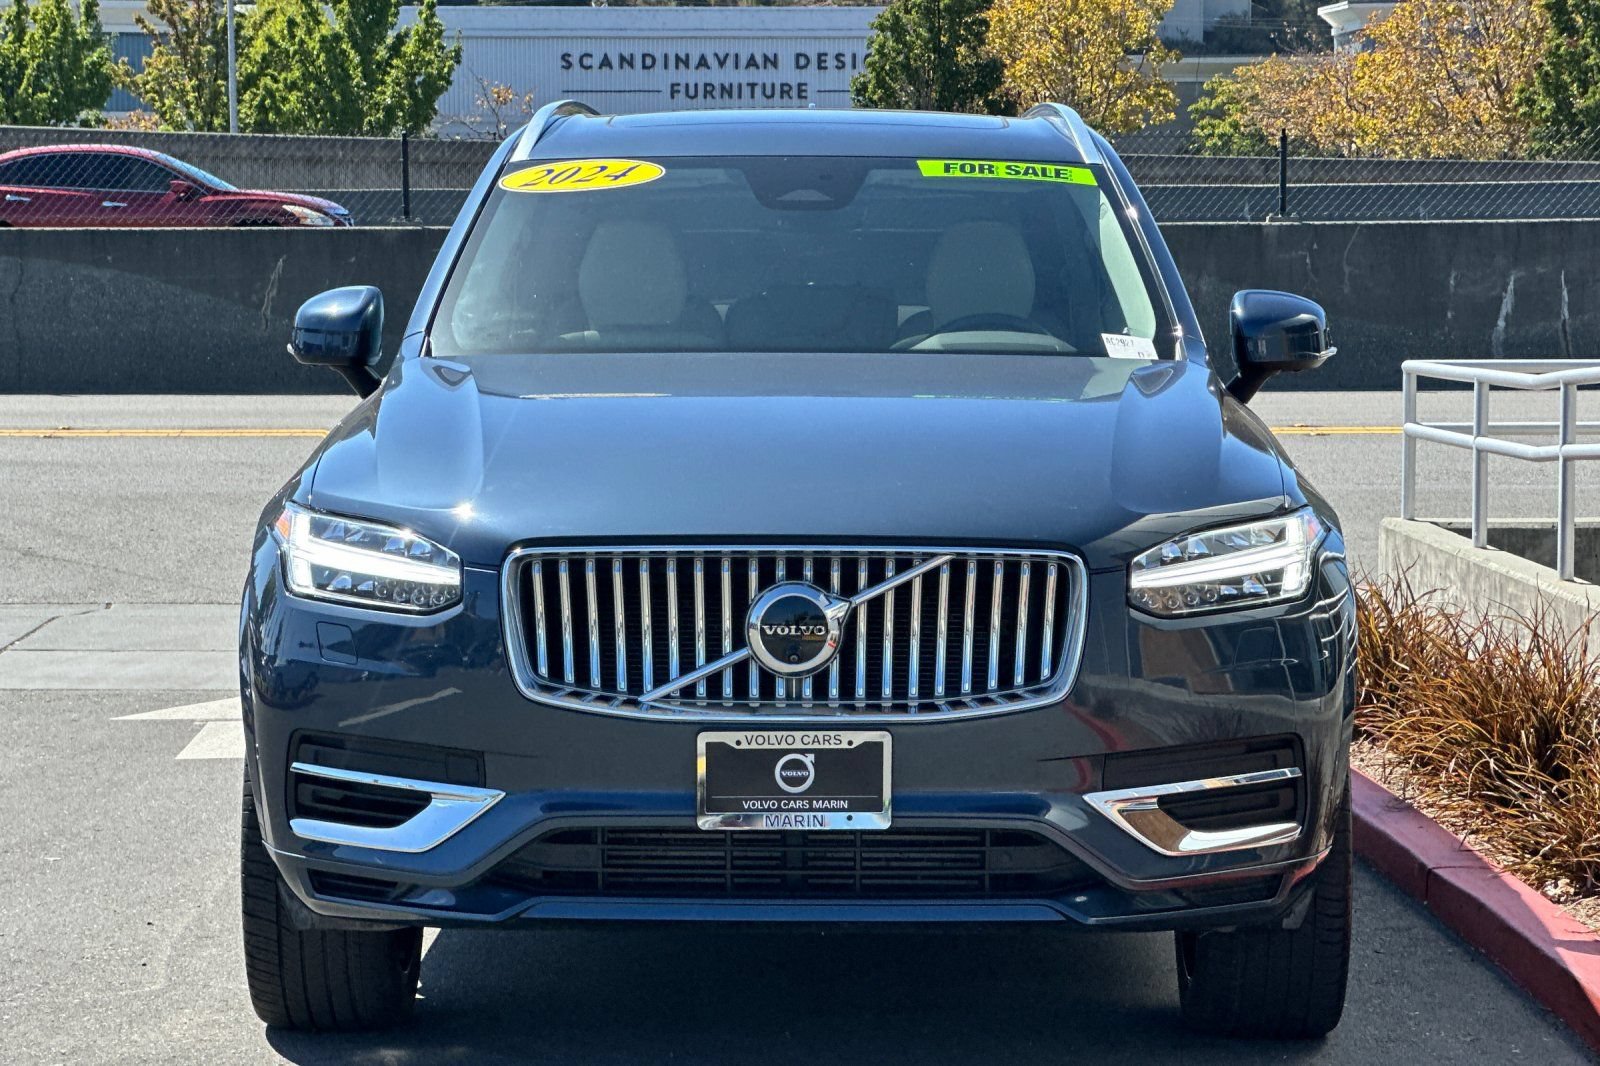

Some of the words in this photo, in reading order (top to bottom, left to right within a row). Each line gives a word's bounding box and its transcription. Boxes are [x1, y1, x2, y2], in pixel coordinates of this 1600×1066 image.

[560, 52, 779, 71] SCANDINAVIAN
[669, 82, 808, 100] FURNITURE
[518, 164, 642, 188] 2024
[943, 162, 996, 176] FOR
[1005, 164, 1072, 181] SALE
[761, 625, 826, 636] VOLVO
[744, 734, 796, 746] VOLVO
[800, 734, 843, 746] CARS
[742, 800, 778, 809] VOLVO
[780, 800, 810, 809] CARS
[812, 800, 848, 809] MARIN
[763, 814, 826, 828] MARIN
